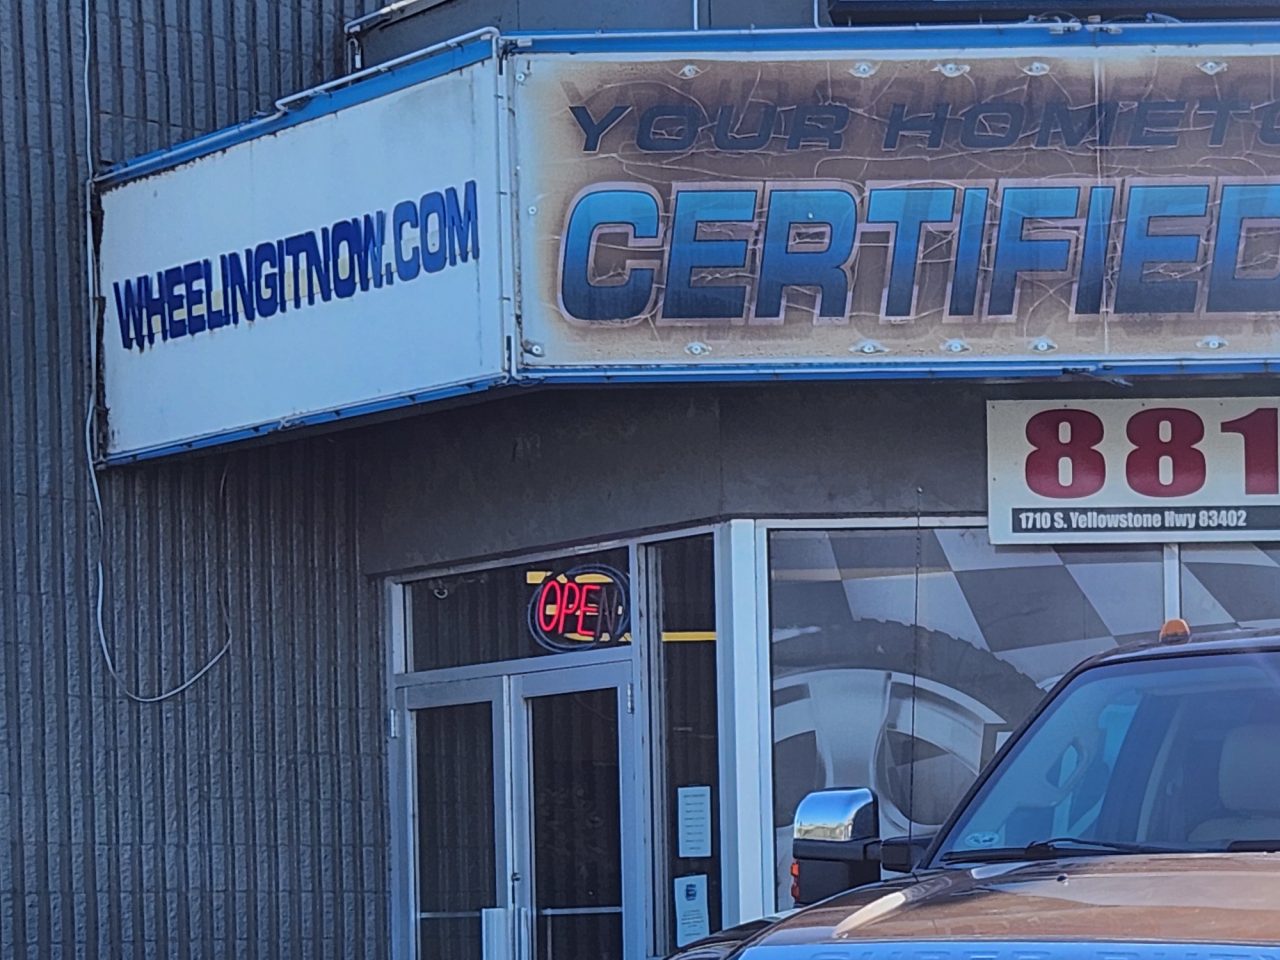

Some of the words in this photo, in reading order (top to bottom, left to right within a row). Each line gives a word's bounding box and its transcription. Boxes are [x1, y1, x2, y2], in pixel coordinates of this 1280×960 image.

[569, 104, 849, 152] YOUR
[113, 180, 479, 350] WHEELINGITNOW.COM
[1019, 512, 1050, 529] 1710
[1053, 513, 1067, 529] S.
[1070, 511, 1161, 529] Yellowstone
[1164, 511, 1196, 528] Hwy
[1199, 510, 1247, 527] 83402
[540, 580, 618, 637] OPEN
